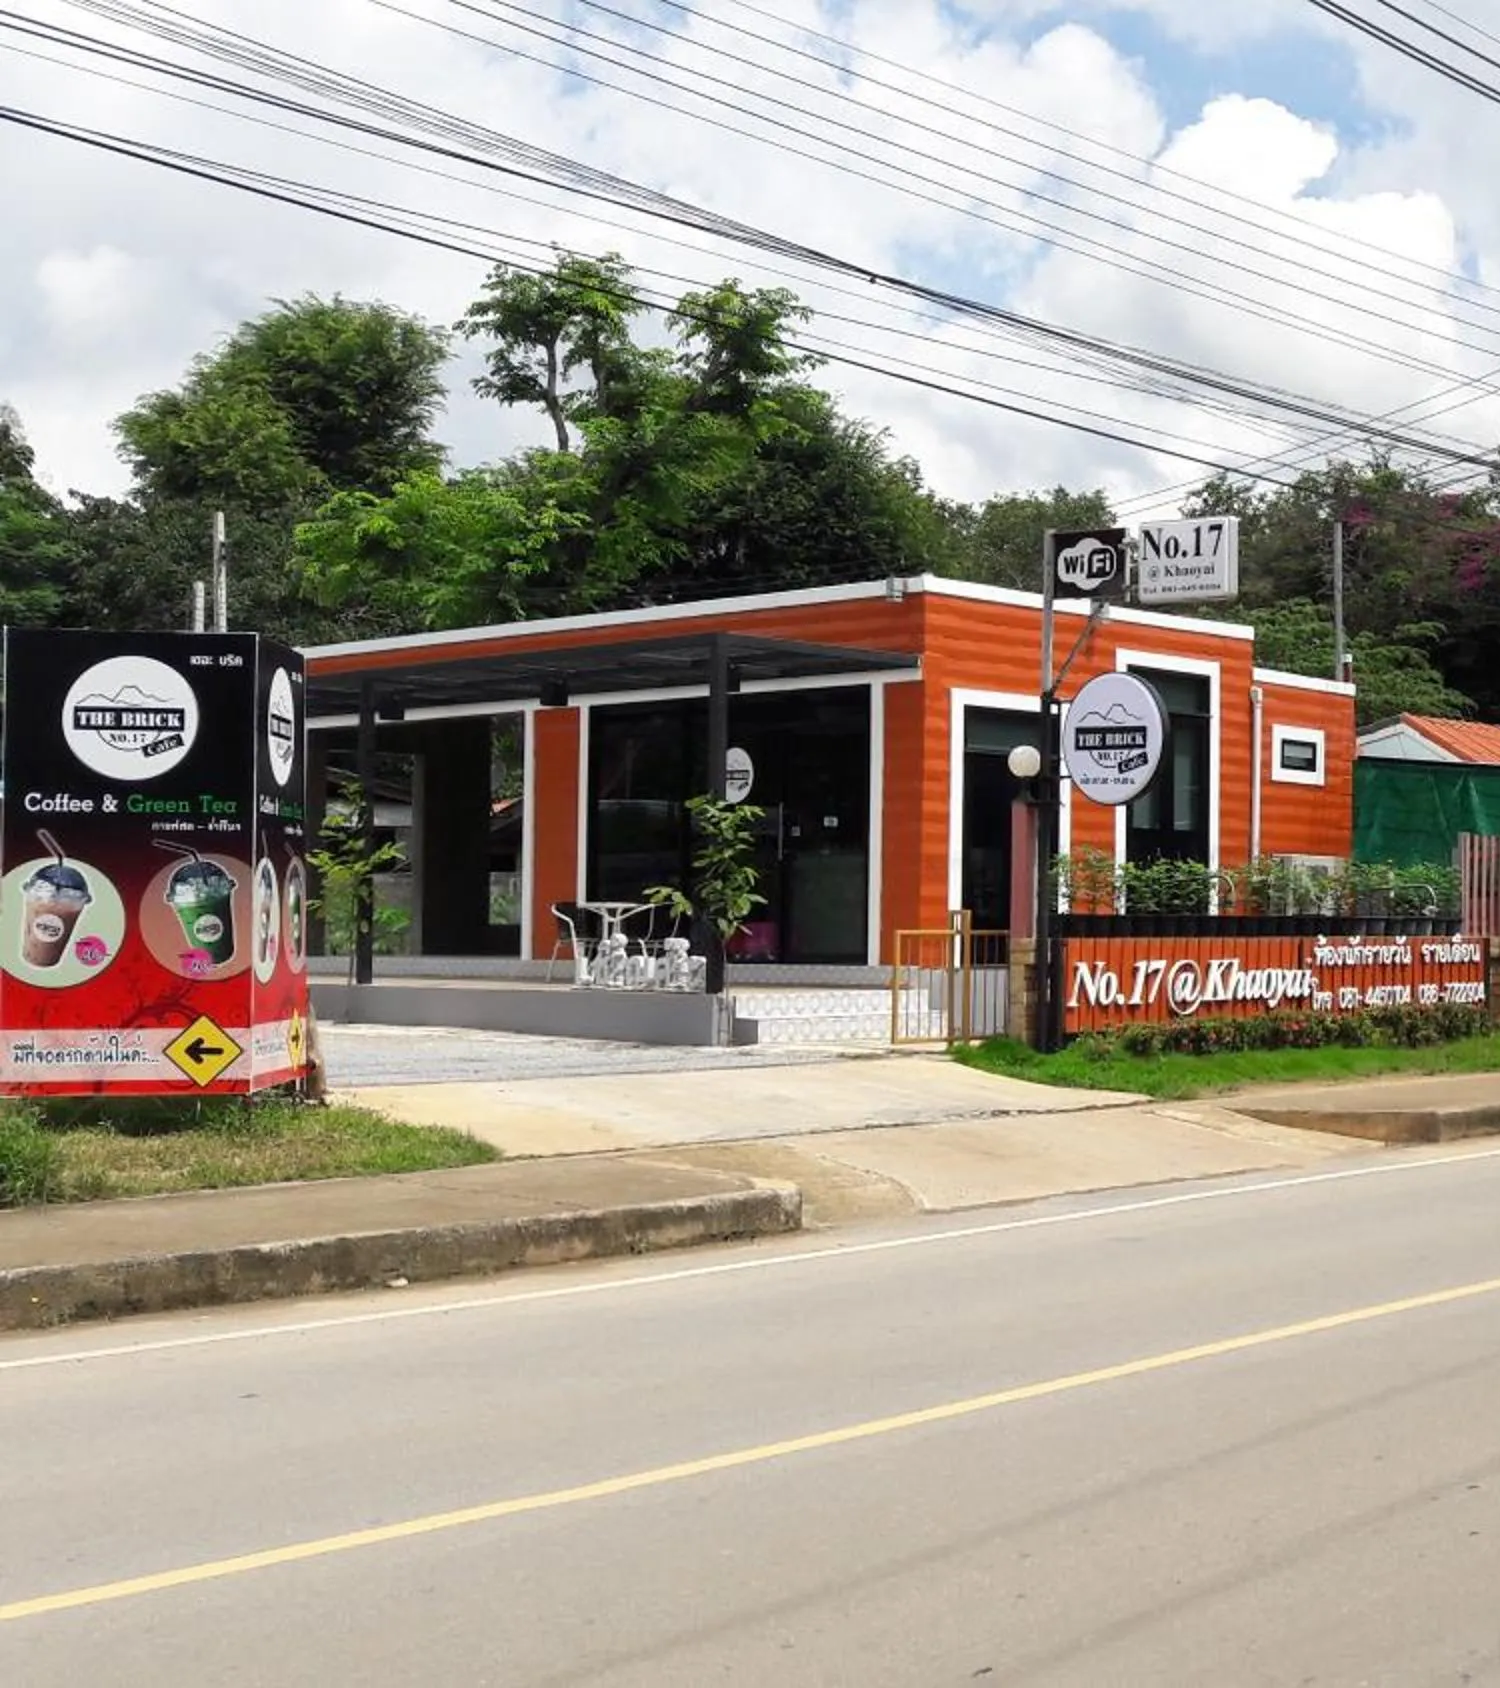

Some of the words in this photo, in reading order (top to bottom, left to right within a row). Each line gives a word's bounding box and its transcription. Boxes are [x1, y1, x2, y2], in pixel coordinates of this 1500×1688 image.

[1141, 523, 1224, 561] No.17
[1063, 547, 1112, 579] WiFi
[1164, 563, 1215, 579] Khaoyai
[77, 711, 117, 727] THE
[121, 711, 182, 728] BRICK
[109, 732, 147, 743] NO.17
[1078, 733, 1103, 748] THE
[1105, 731, 1145, 746] BRICK
[24, 792, 95, 812] Coffee
[102, 793, 119, 813] &
[126, 793, 191, 813] Green
[200, 795, 237, 813] Tea
